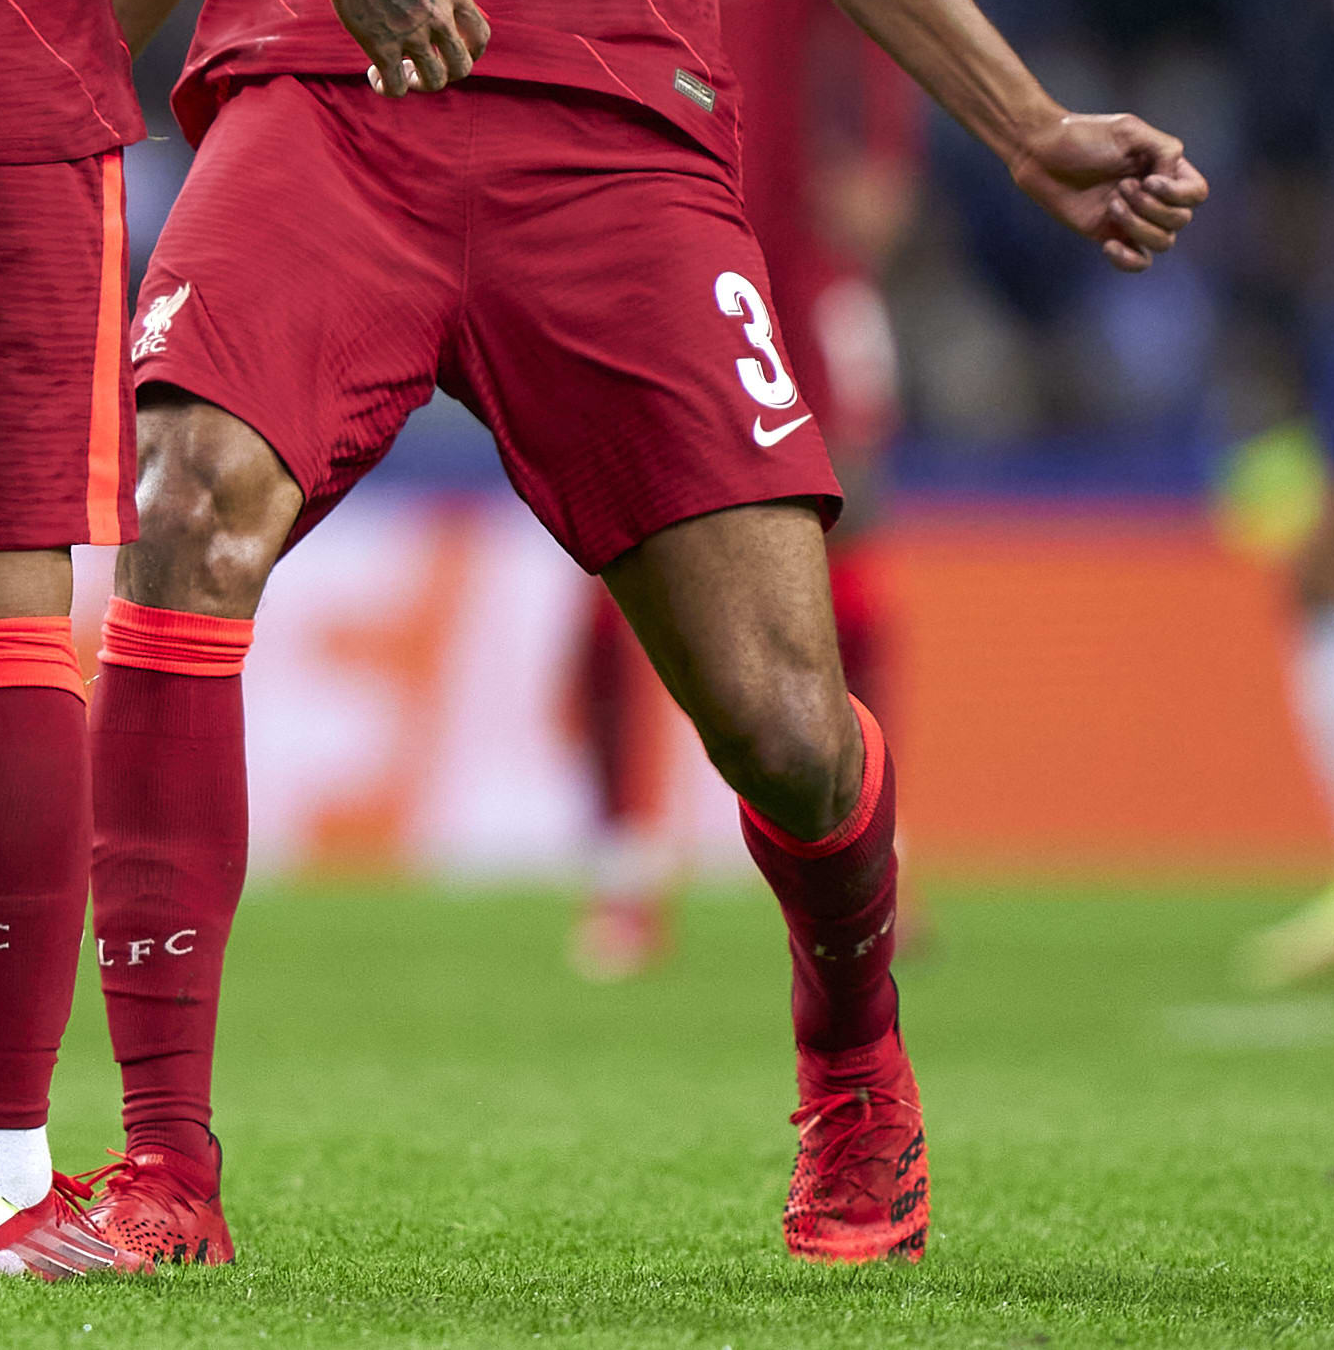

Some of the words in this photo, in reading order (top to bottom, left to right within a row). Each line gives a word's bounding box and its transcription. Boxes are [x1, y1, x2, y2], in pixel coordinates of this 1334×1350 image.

[131, 337, 166, 363] LFC
[715, 271, 798, 410] 3
[97, 929, 197, 966] LFC
